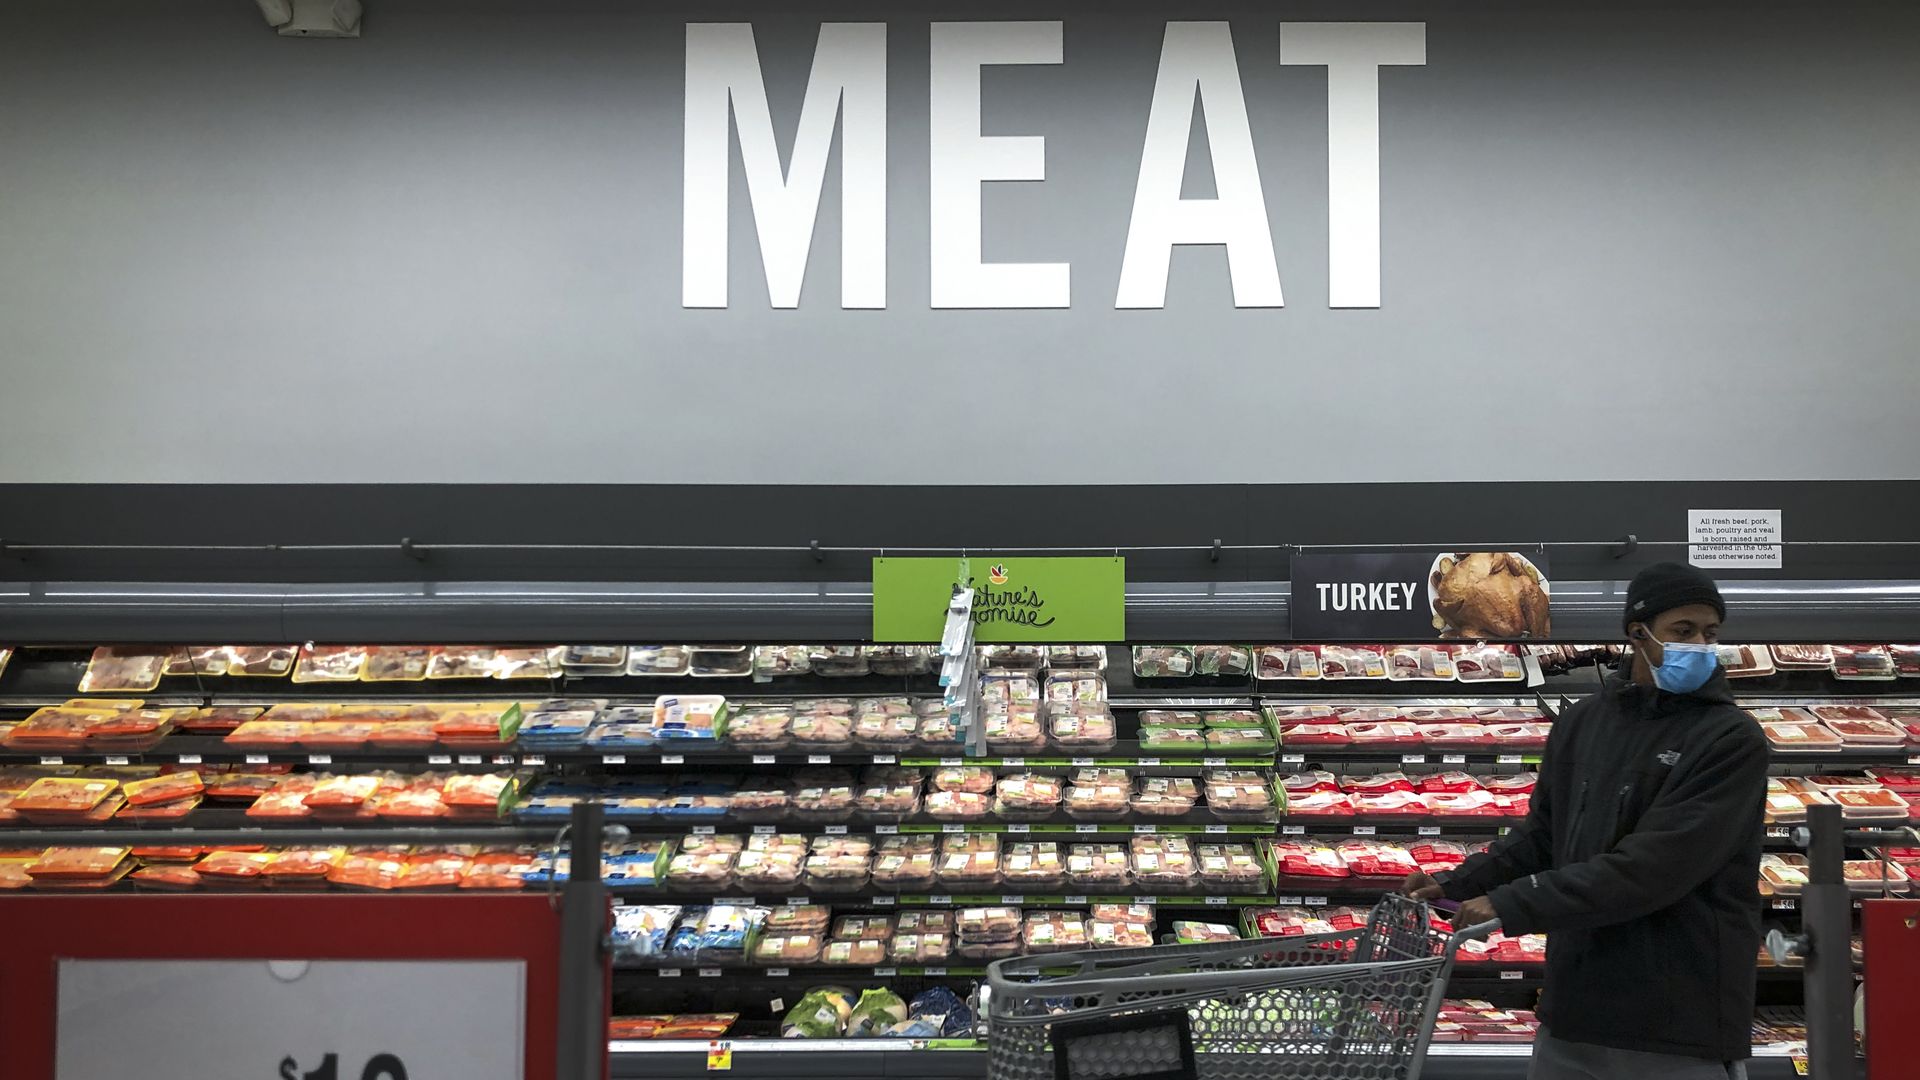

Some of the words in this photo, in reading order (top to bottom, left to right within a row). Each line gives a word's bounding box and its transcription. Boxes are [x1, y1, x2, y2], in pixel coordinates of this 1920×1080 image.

[682, 20, 1427, 309] MEAT
[1716, 527, 1742, 535] poultry
[953, 578, 1045, 608] ature's
[1315, 582, 1417, 611] TURKEY
[946, 606, 1056, 628] romise
